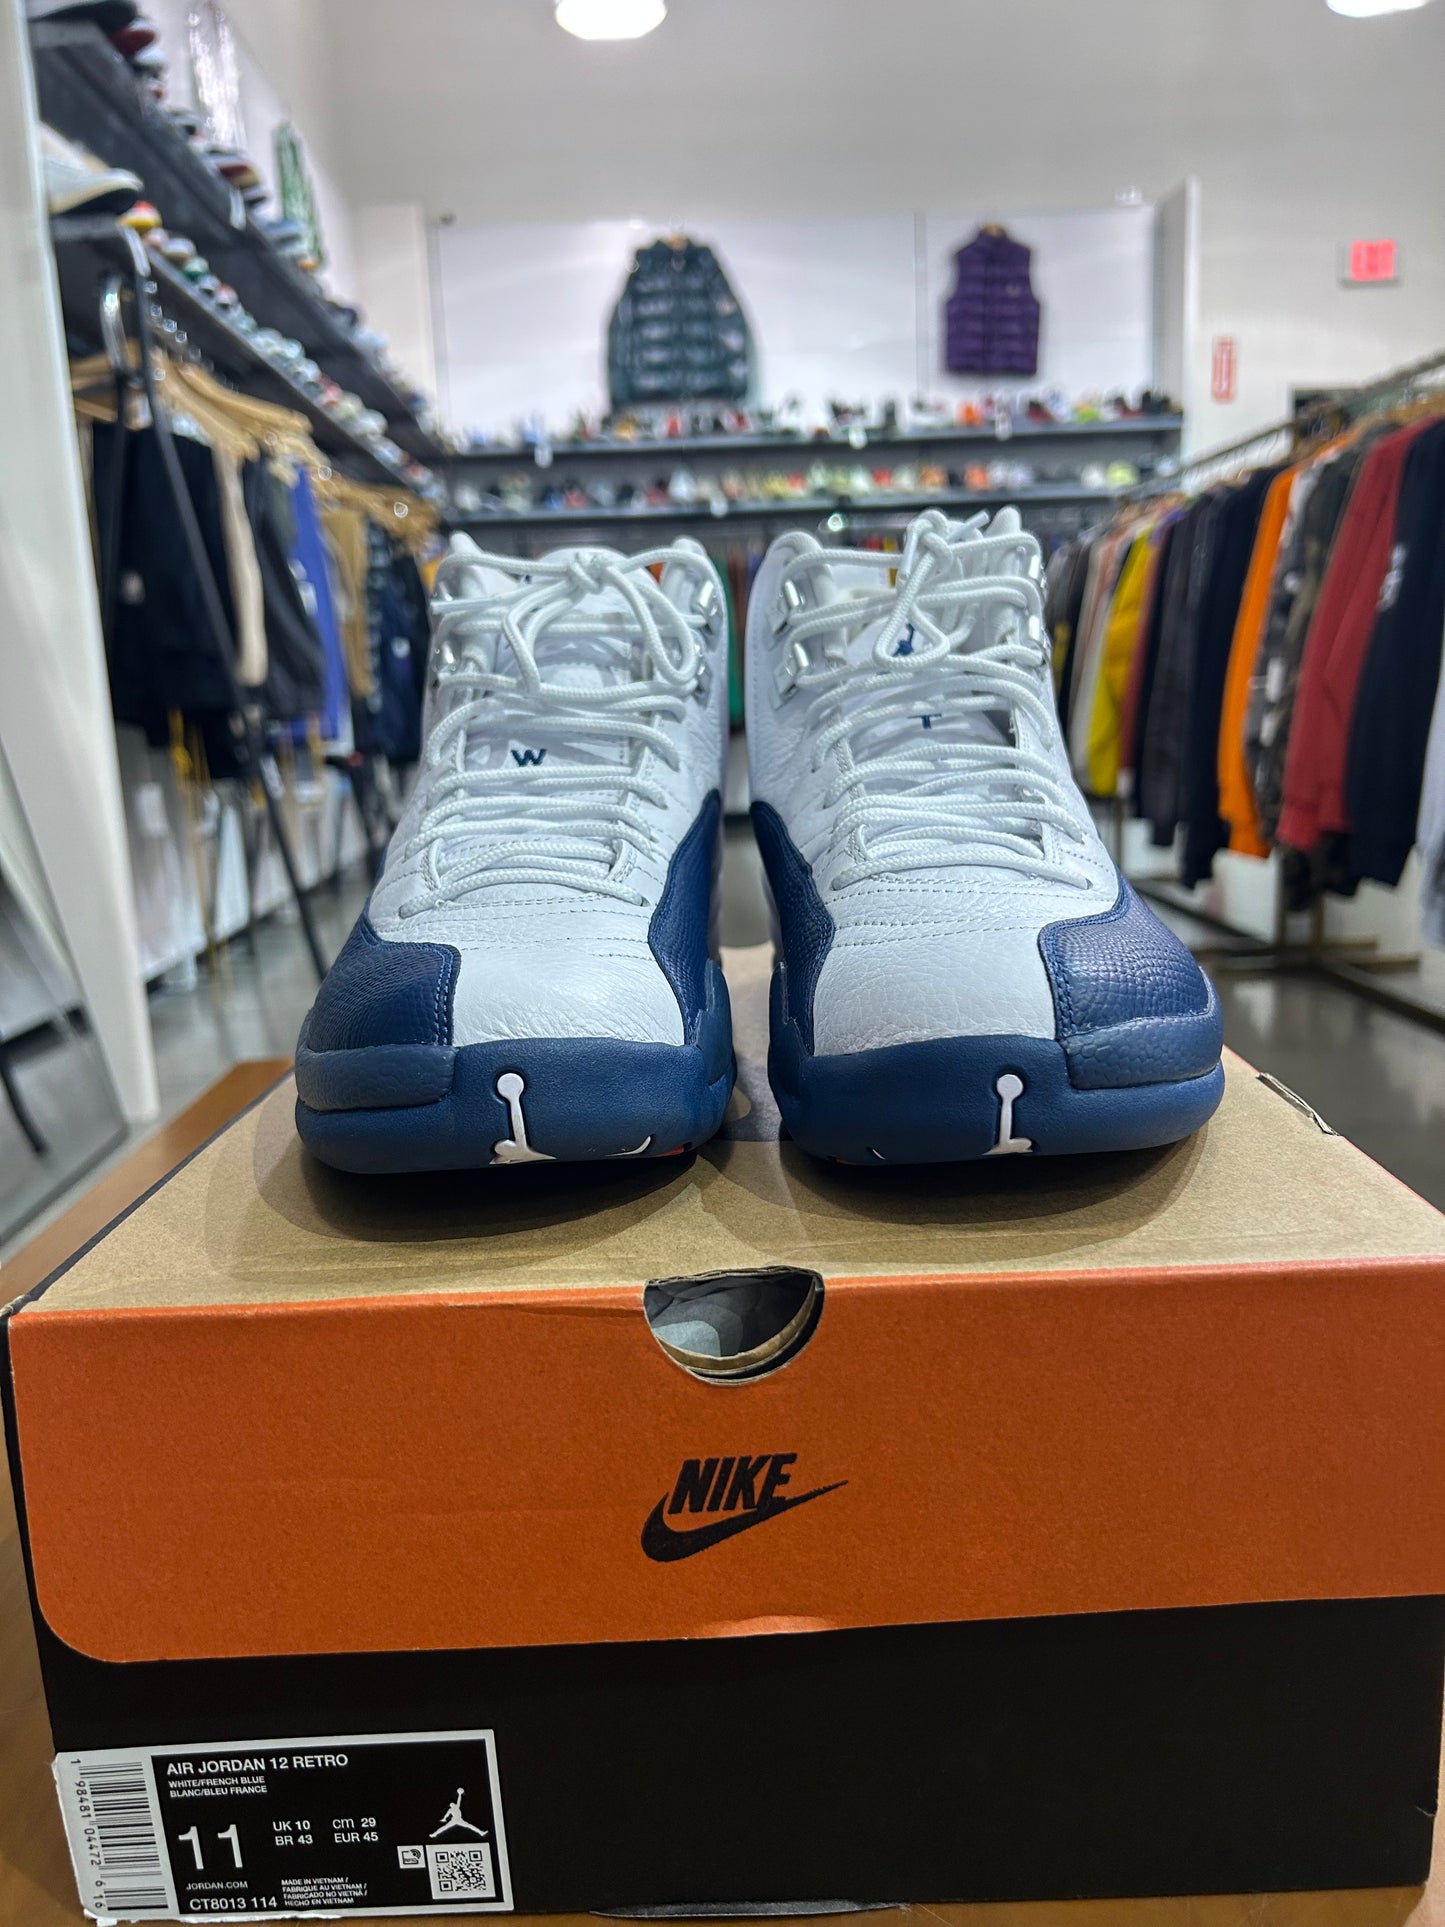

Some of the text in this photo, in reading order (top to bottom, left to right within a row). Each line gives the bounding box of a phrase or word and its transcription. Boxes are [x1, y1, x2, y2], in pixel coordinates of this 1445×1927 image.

[667, 1452, 798, 1515] NIKE
[166, 1754, 349, 1776] AIR JORDAN 12 RETRO
[168, 1775, 265, 1789] WHITE/FRENCH BLUE
[169, 1784, 268, 1798] BLANC/BLEU FRANCE
[74, 1780, 92, 1819] 98481
[84, 1828, 102, 1866] 04472
[272, 1820, 311, 1832] UK 10
[360, 1817, 377, 1828] 29
[275, 1834, 314, 1846] BR 43
[334, 1831, 379, 1843] EUR 45
[178, 1823, 243, 1870] 11
[185, 1880, 249, 1891] JORDAN.COM
[281, 1878, 303, 1886] MADE
[282, 1885, 318, 1893] FABRIQUE
[283, 1891, 325, 1899] FABRICADO
[189, 1896, 278, 1911] CT8013 114
[284, 1899, 310, 1907] HECHO
